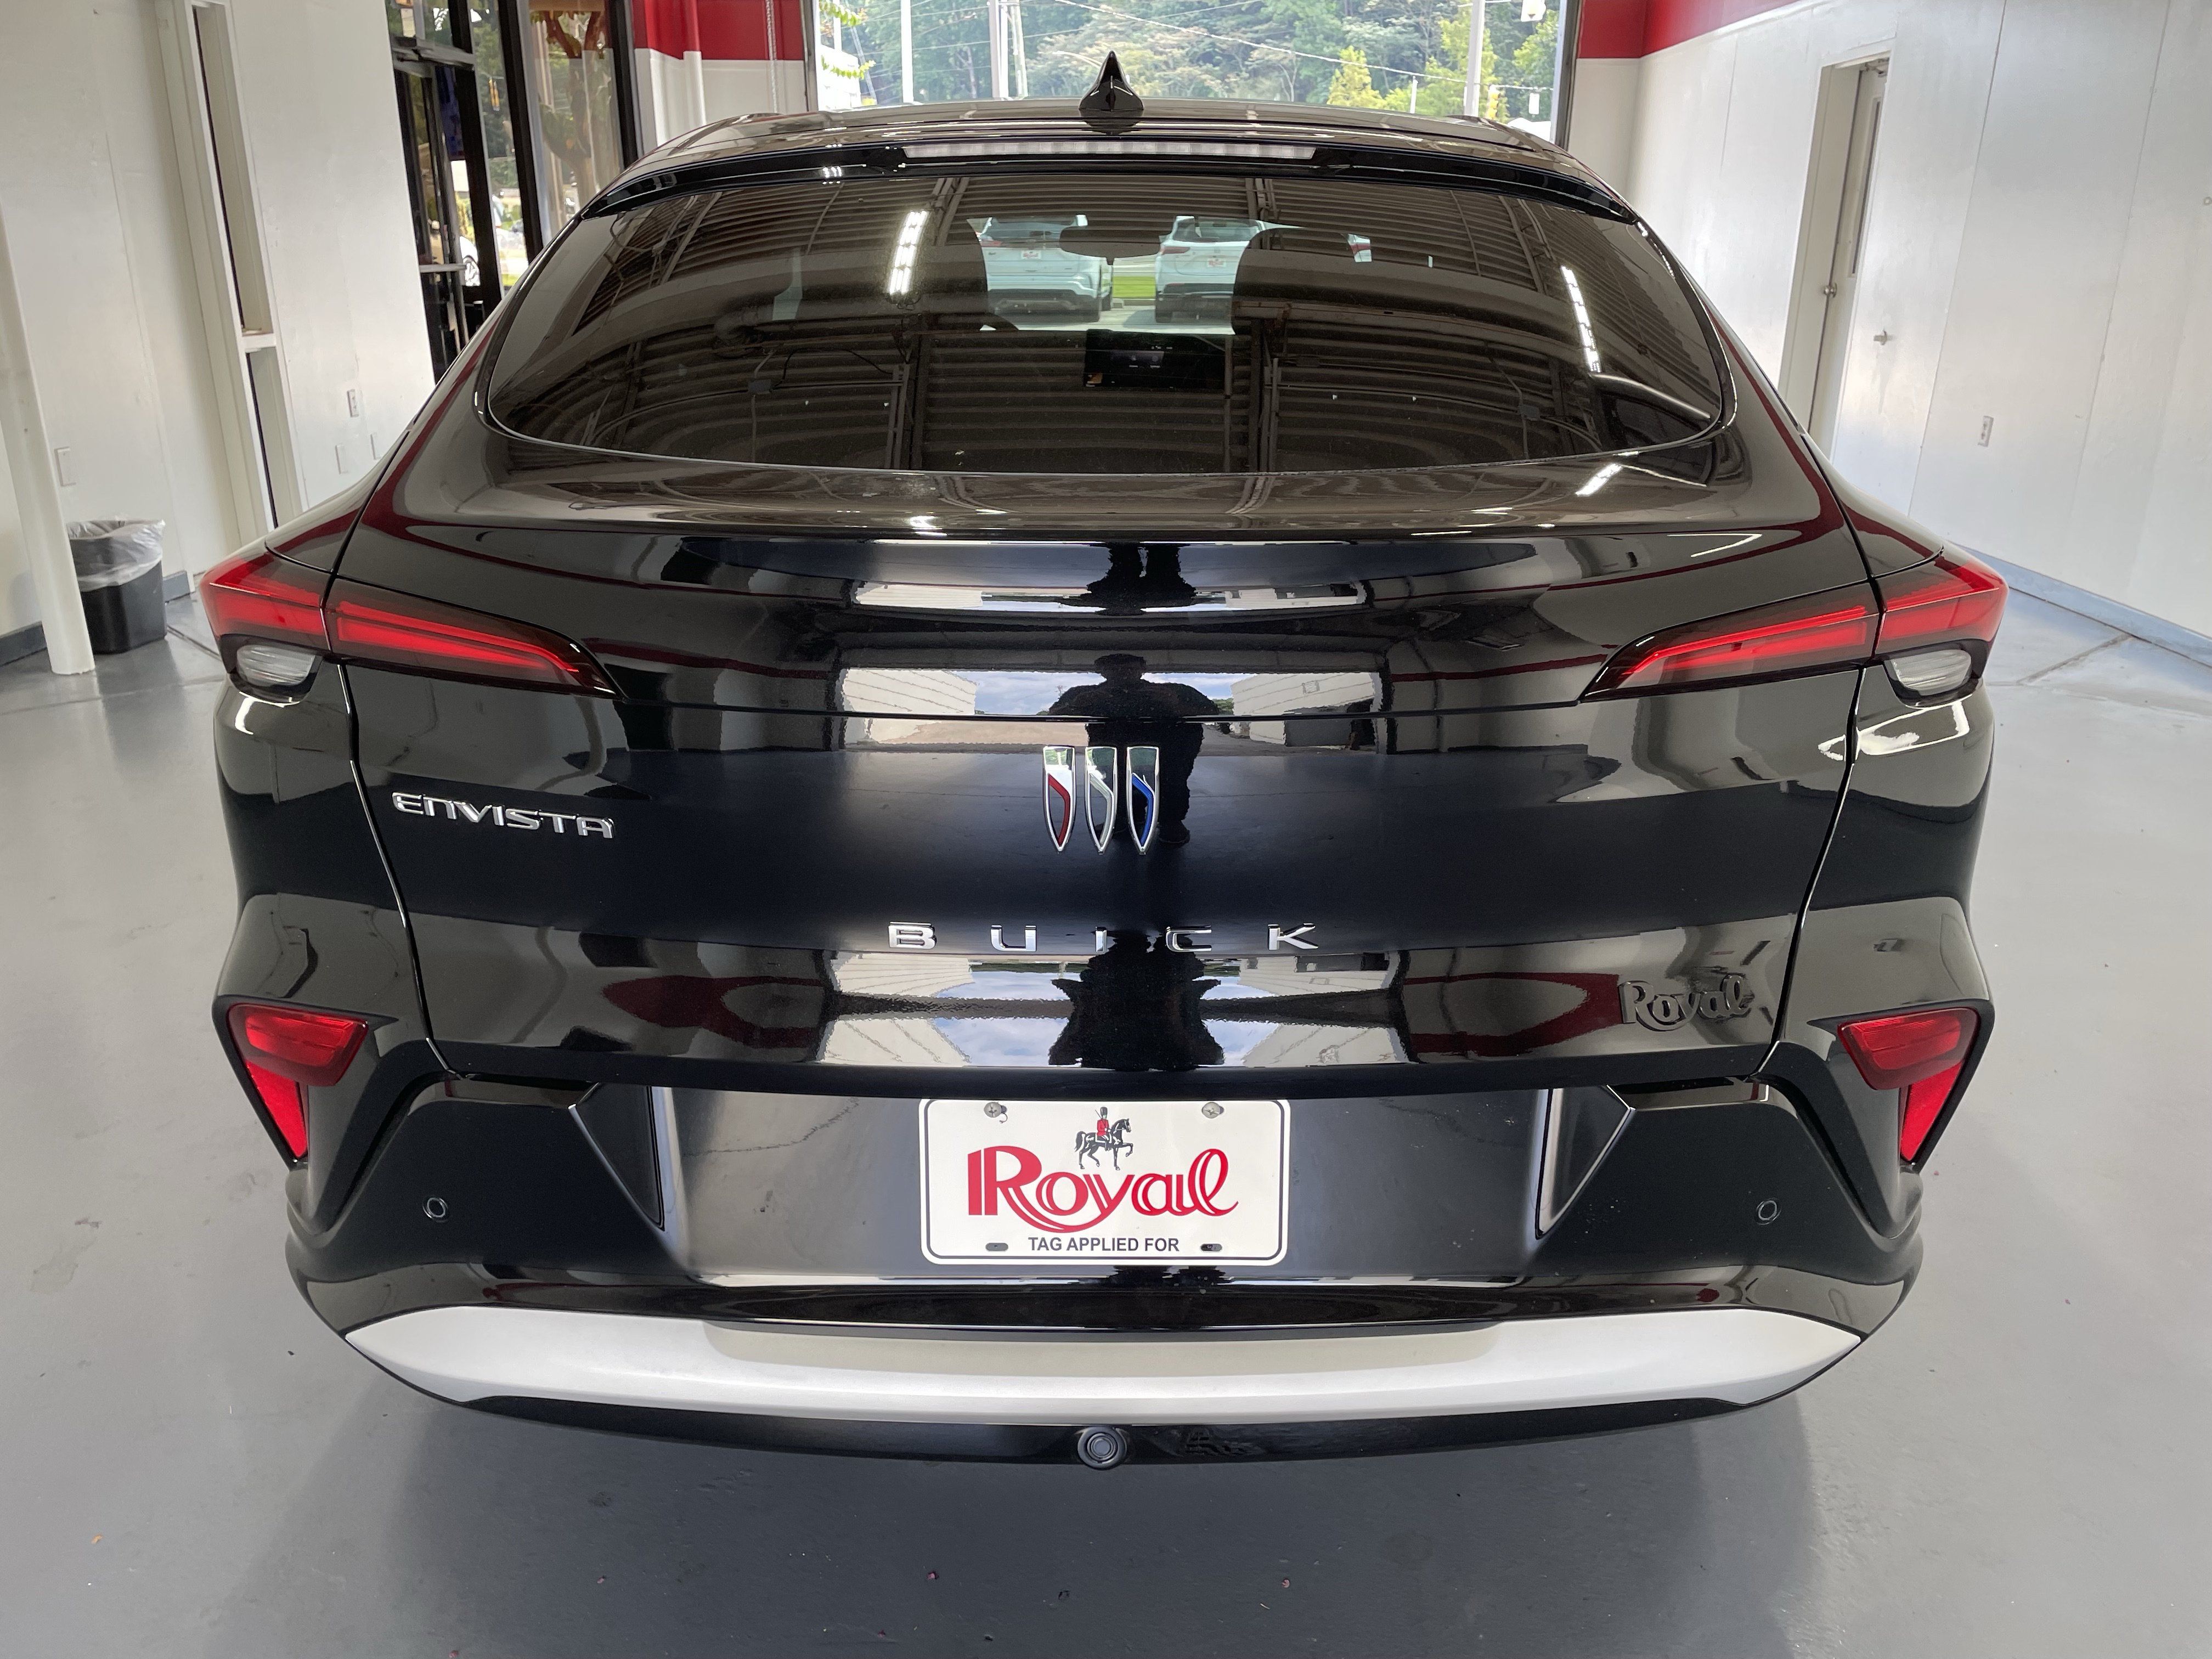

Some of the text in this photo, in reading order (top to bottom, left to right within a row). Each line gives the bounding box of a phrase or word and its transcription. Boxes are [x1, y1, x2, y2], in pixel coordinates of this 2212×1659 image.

[392, 792, 614, 839] ENVISTA
[888, 921, 1319, 953] BUICK
[1619, 973, 1754, 1031] Royal
[968, 1146, 1239, 1233] Royal
[1028, 1237, 1180, 1252] TAG APPLIED FOR
